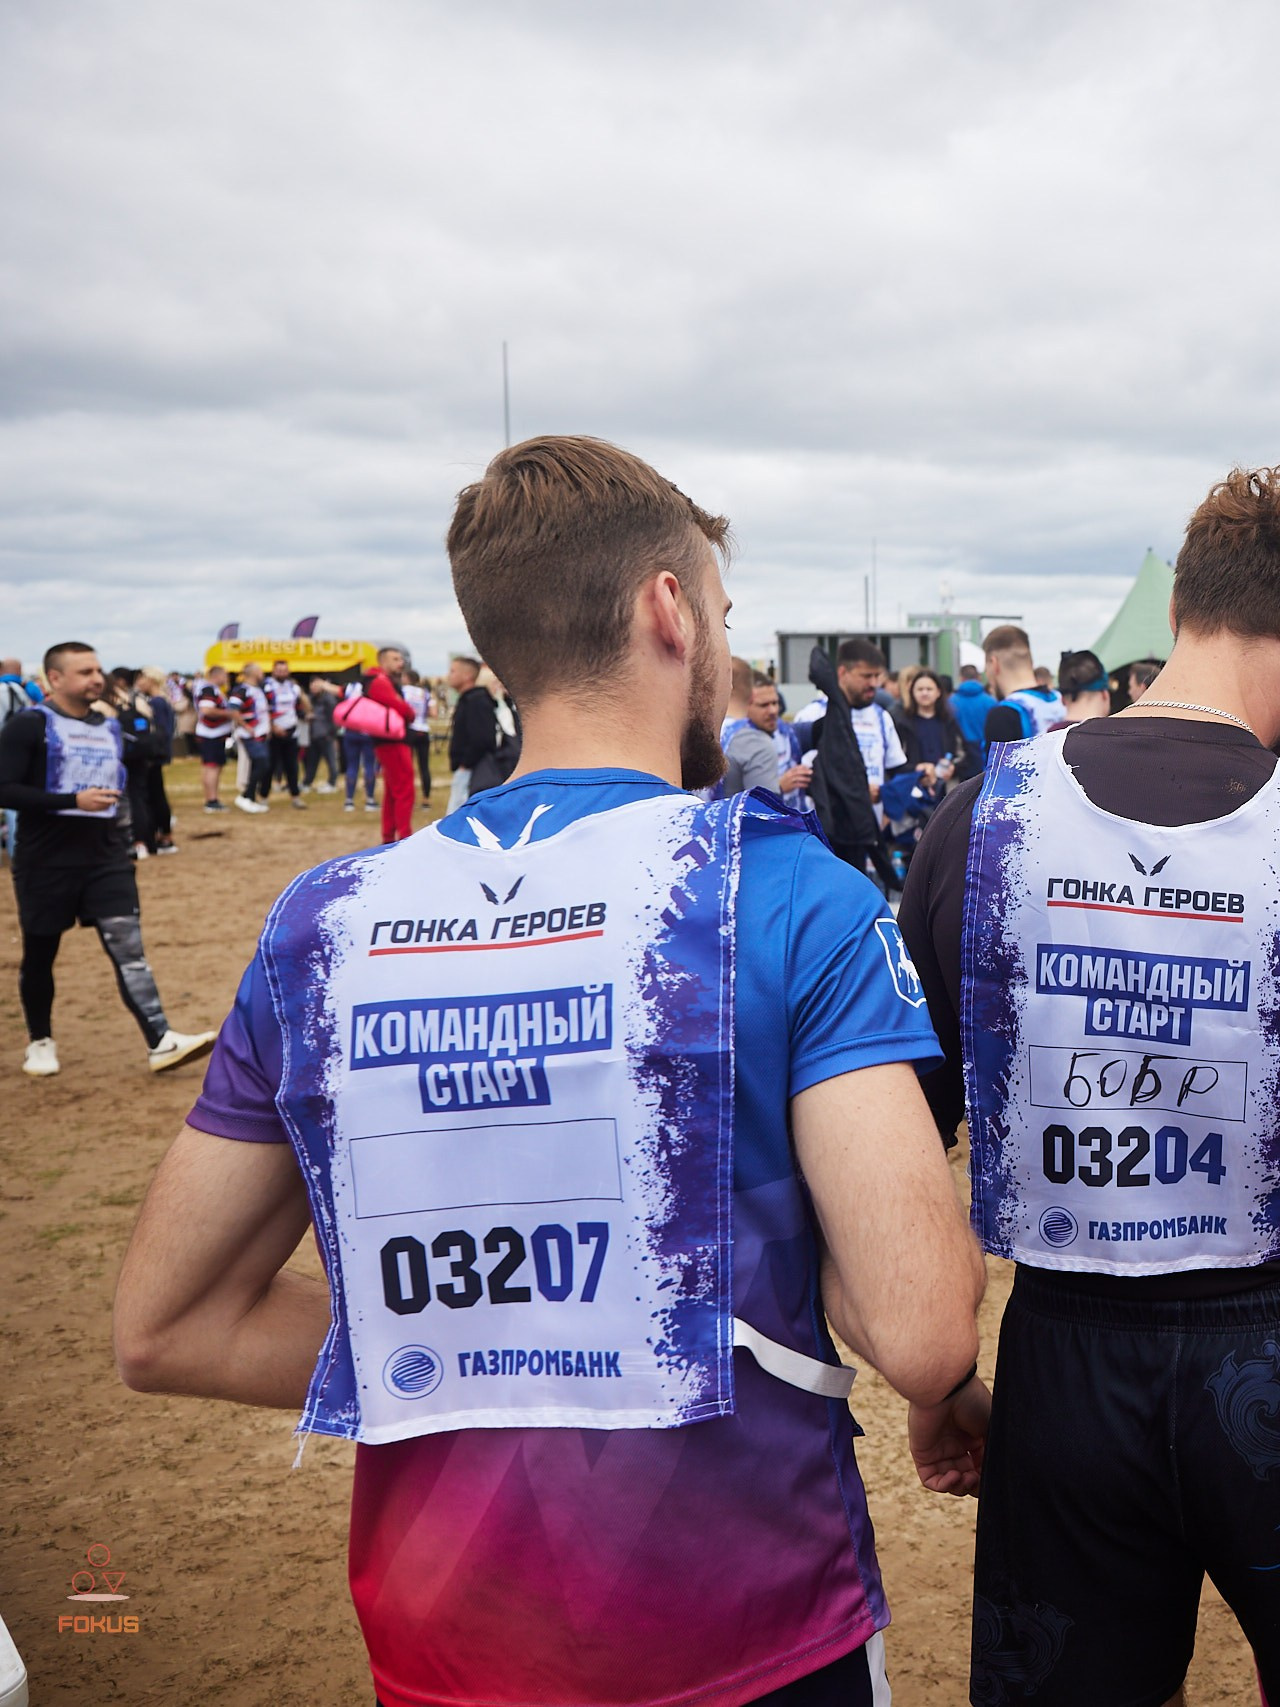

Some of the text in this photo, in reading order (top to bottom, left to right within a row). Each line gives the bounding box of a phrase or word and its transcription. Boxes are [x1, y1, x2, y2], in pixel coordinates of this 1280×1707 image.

[1047, 878, 1245, 914] ГОНКА ГЕРОЕВ
[370, 902, 607, 945] ГОНКА ГЕРОЕВ
[1040, 952, 1245, 1003] КОМАНДНЫЙ
[354, 984, 607, 1059] КОМАНДНЫЙ
[1092, 998, 1185, 1040] СТАРТ
[425, 1057, 538, 1106] СТАРТ
[1064, 1052, 1219, 1107] БОБР
[1042, 1124, 1227, 1187] 03204
[1088, 1215, 1227, 1242] ГАЗПРОМБАНК
[380, 1222, 609, 1316] 03207
[457, 1349, 622, 1378] ГАЗПРОМБАНК
